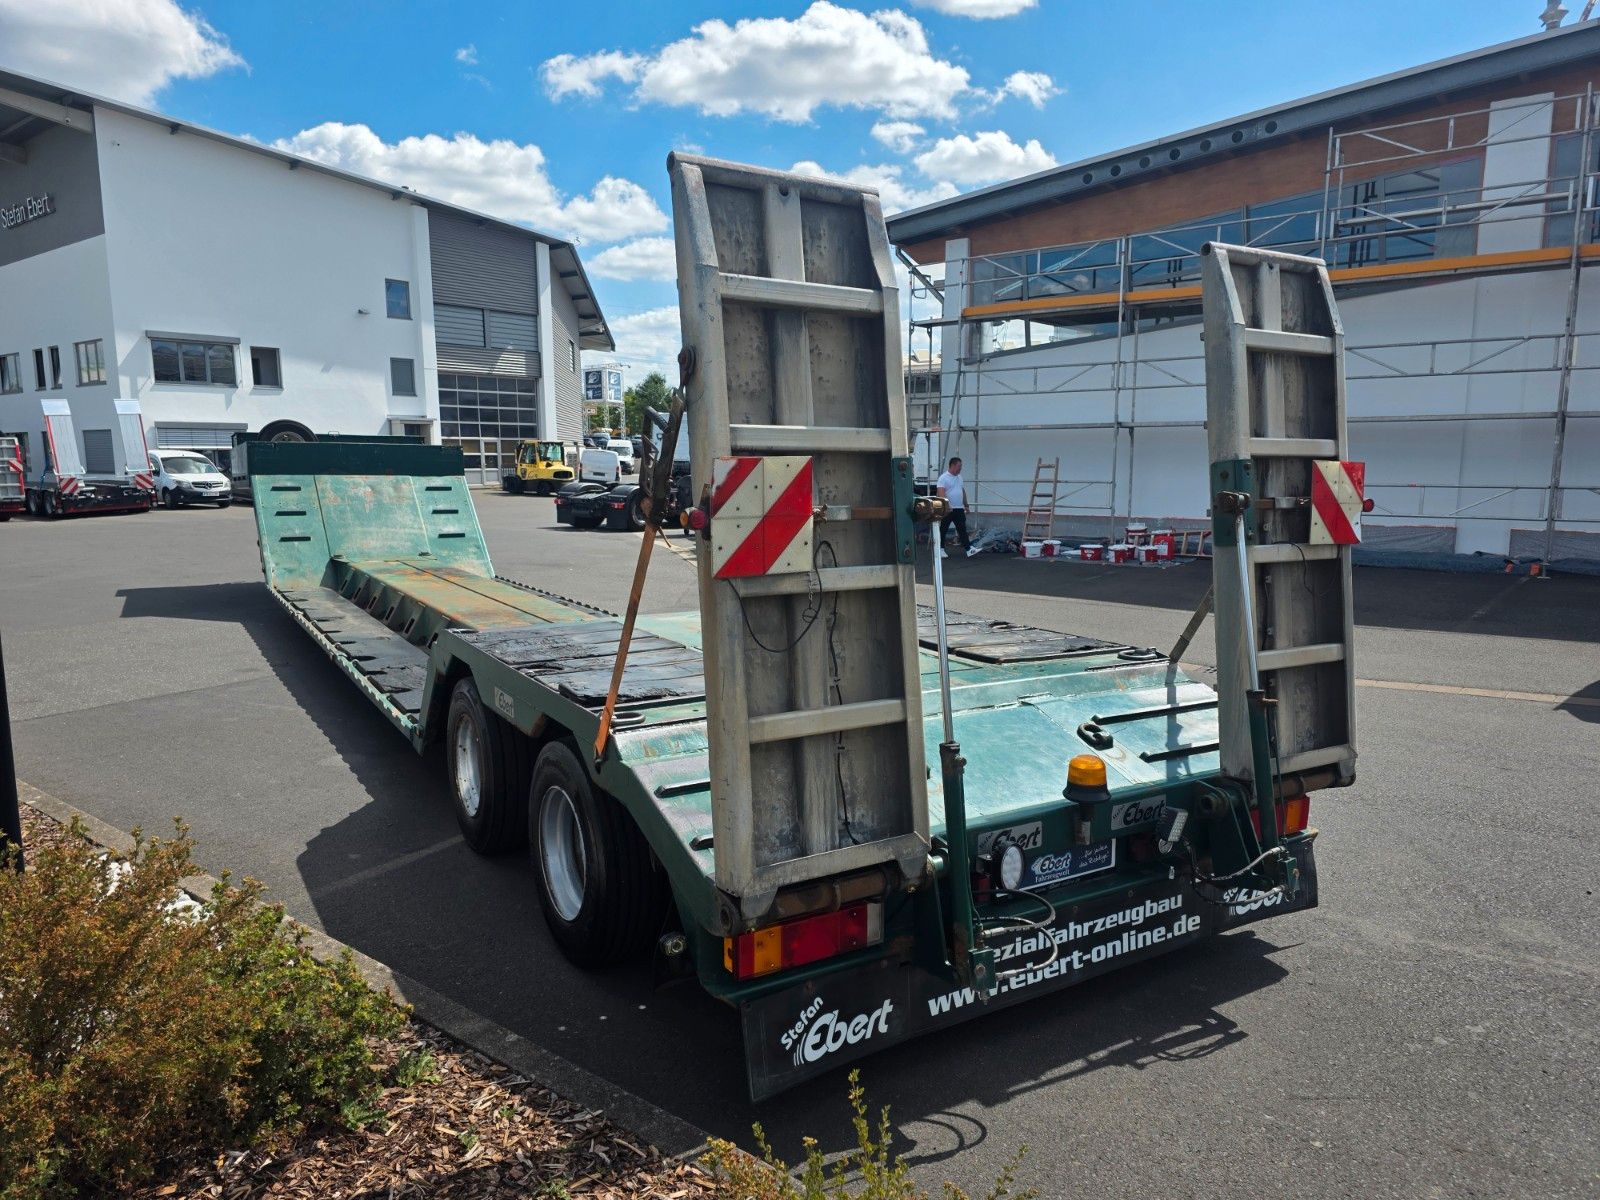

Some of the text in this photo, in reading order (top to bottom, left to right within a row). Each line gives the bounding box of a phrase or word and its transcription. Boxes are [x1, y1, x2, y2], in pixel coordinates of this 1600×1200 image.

[1, 193, 50, 228] Stefan Ebert
[1123, 799, 1166, 826] Ebert
[1040, 853, 1072, 873] Ebert
[993, 894, 1183, 963] ezialfahrzeugbau
[928, 914, 1200, 1016] ww.ebert-online.de
[781, 996, 824, 1050] Stefan
[803, 999, 893, 1062] Ebert
